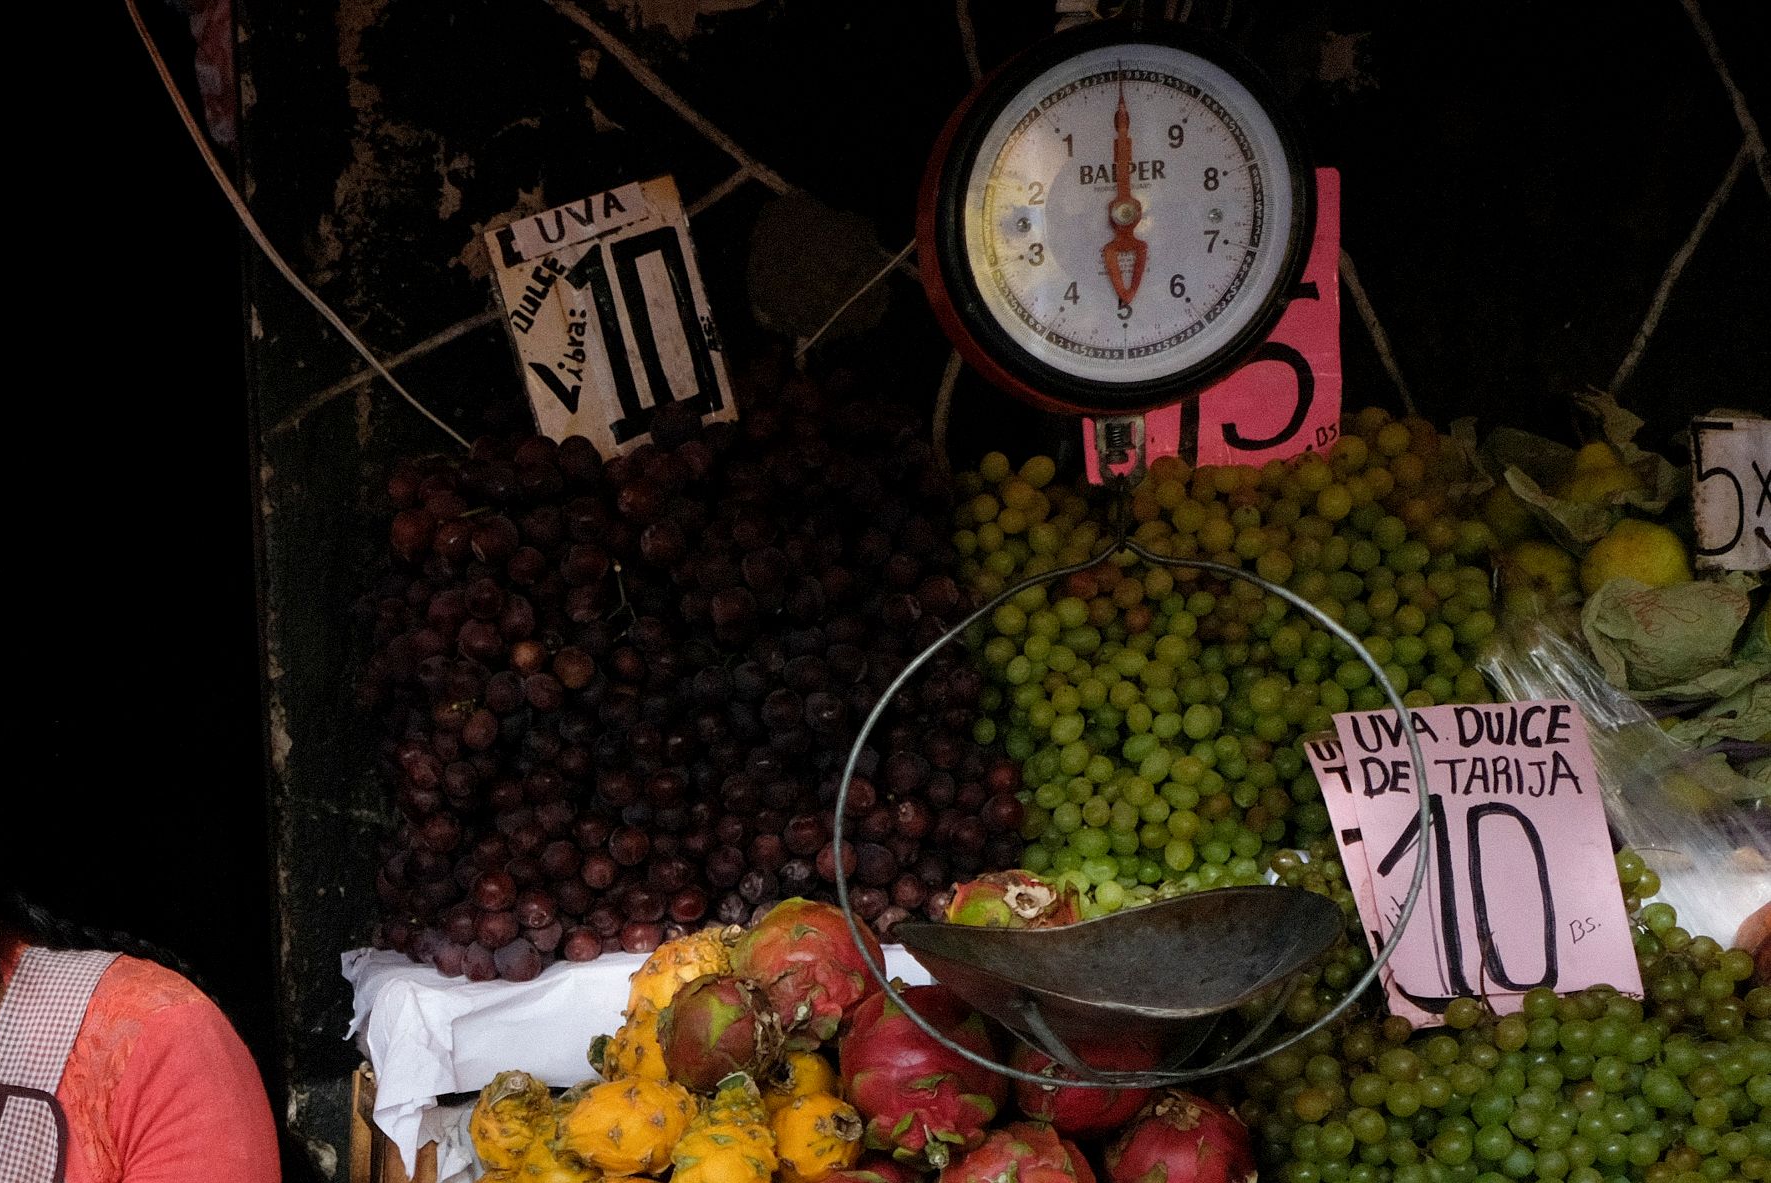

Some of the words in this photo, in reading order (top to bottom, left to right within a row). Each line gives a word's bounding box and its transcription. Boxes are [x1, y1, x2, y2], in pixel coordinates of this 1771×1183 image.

[1062, 133, 1074, 158] 1
[1167, 124, 1185, 149] 9
[1203, 167, 1220, 191] 8
[1028, 181, 1044, 206] 2
[534, 191, 626, 243] UVA
[1028, 242, 1045, 267] 3
[1203, 230, 1221, 254] 7
[1063, 281, 1080, 306] 4
[1169, 273, 1186, 299] 6
[564, 225, 725, 446] 10
[1359, 756, 1411, 799] DE
[1434, 750, 1583, 798] TARIJA
[1377, 793, 1559, 996] 10
